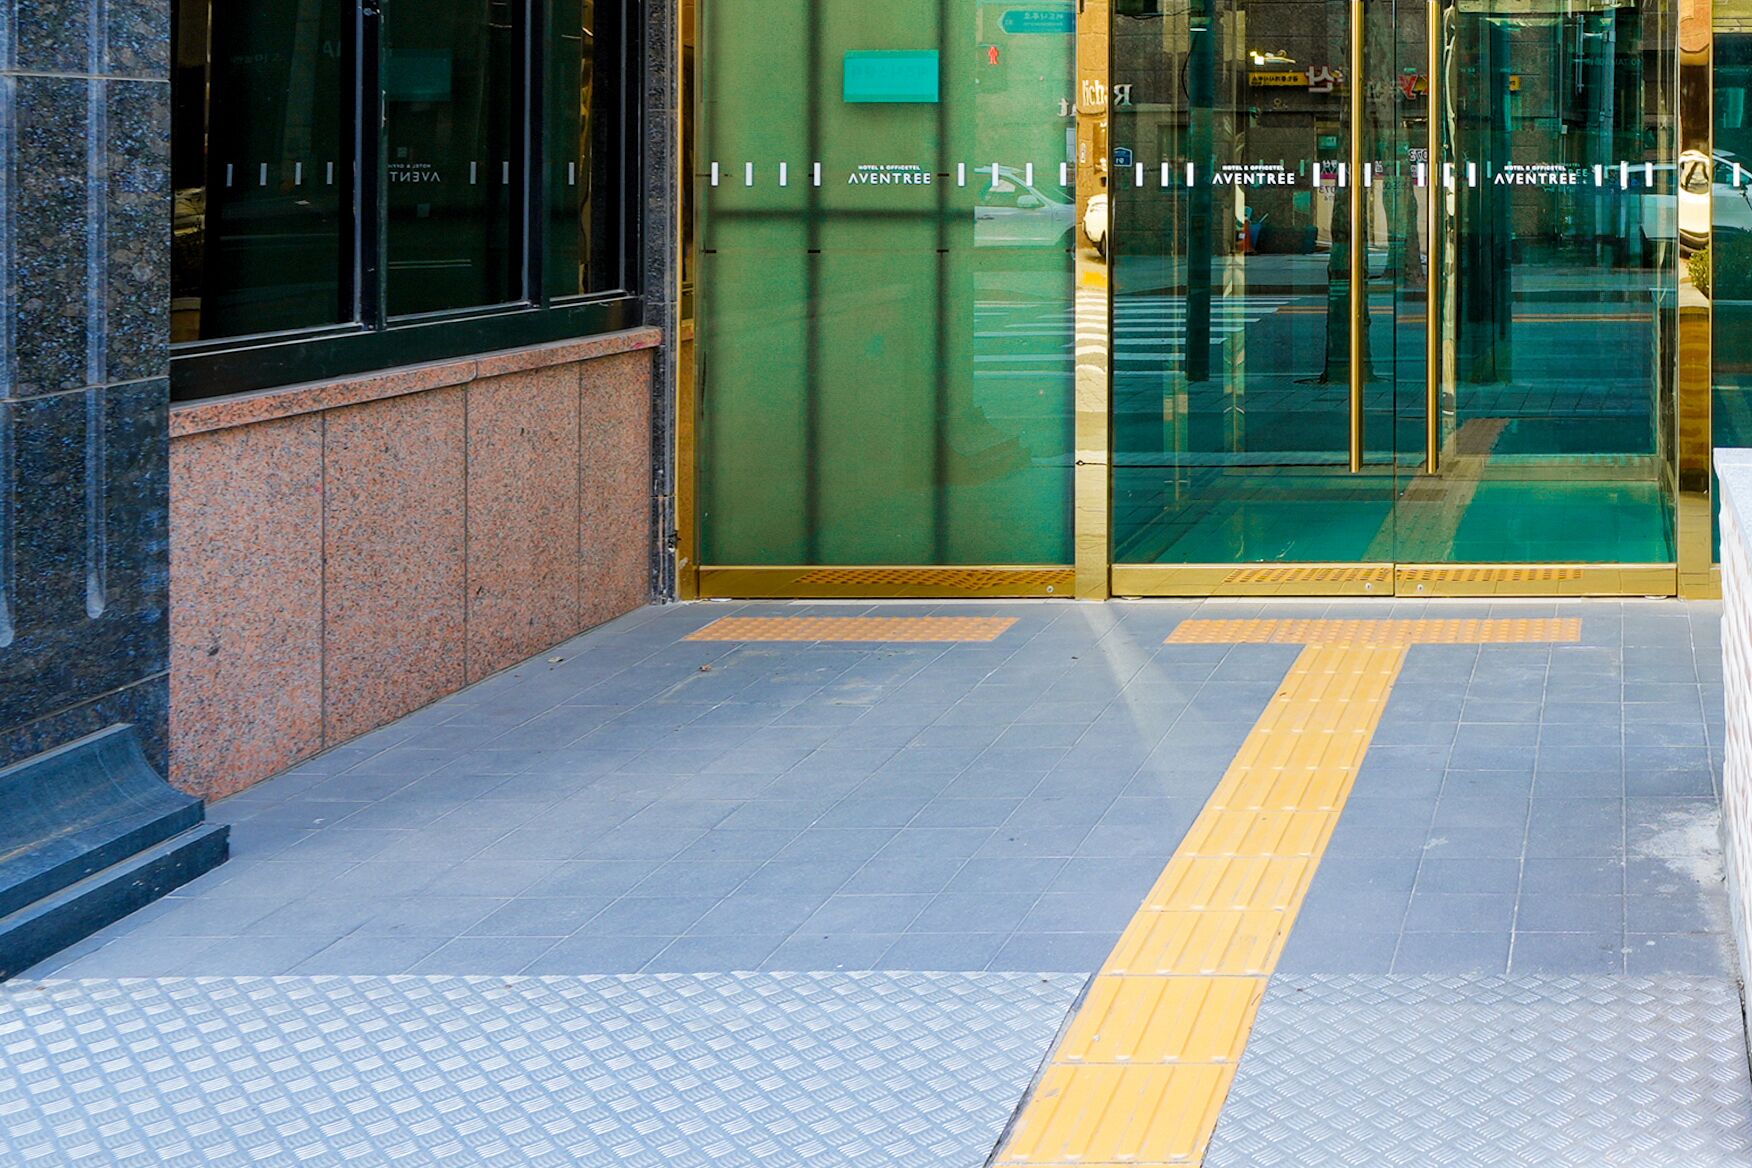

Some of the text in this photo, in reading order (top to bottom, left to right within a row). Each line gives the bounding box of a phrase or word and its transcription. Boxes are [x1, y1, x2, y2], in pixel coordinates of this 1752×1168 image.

[848, 173, 931, 183] AVENTREE
[1212, 172, 1295, 184] AVENTREE
[1494, 173, 1577, 184] AVENTREE
